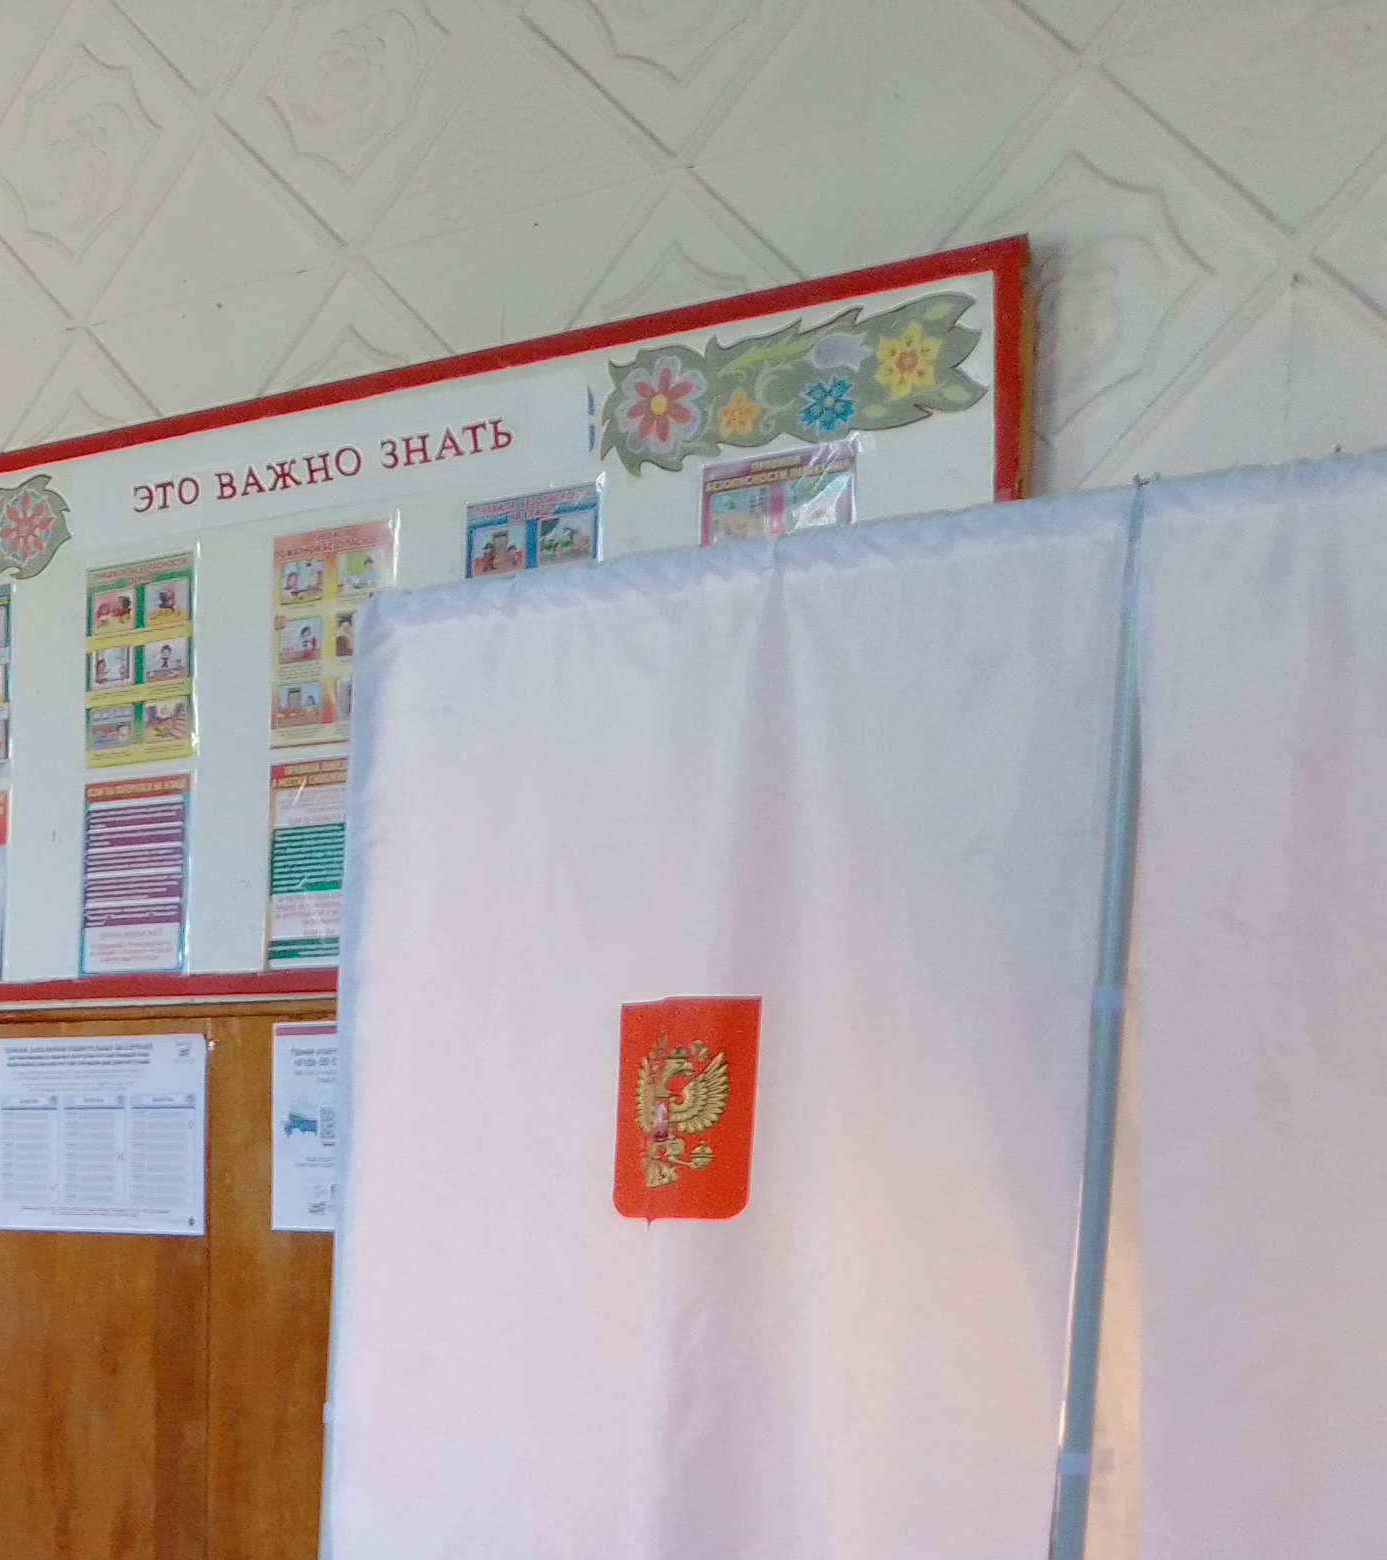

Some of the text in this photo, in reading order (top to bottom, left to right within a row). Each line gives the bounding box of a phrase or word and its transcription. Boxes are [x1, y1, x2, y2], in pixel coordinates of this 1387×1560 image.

[132, 418, 514, 513] ЭТО ВАЖНО ЗНАТЬ
